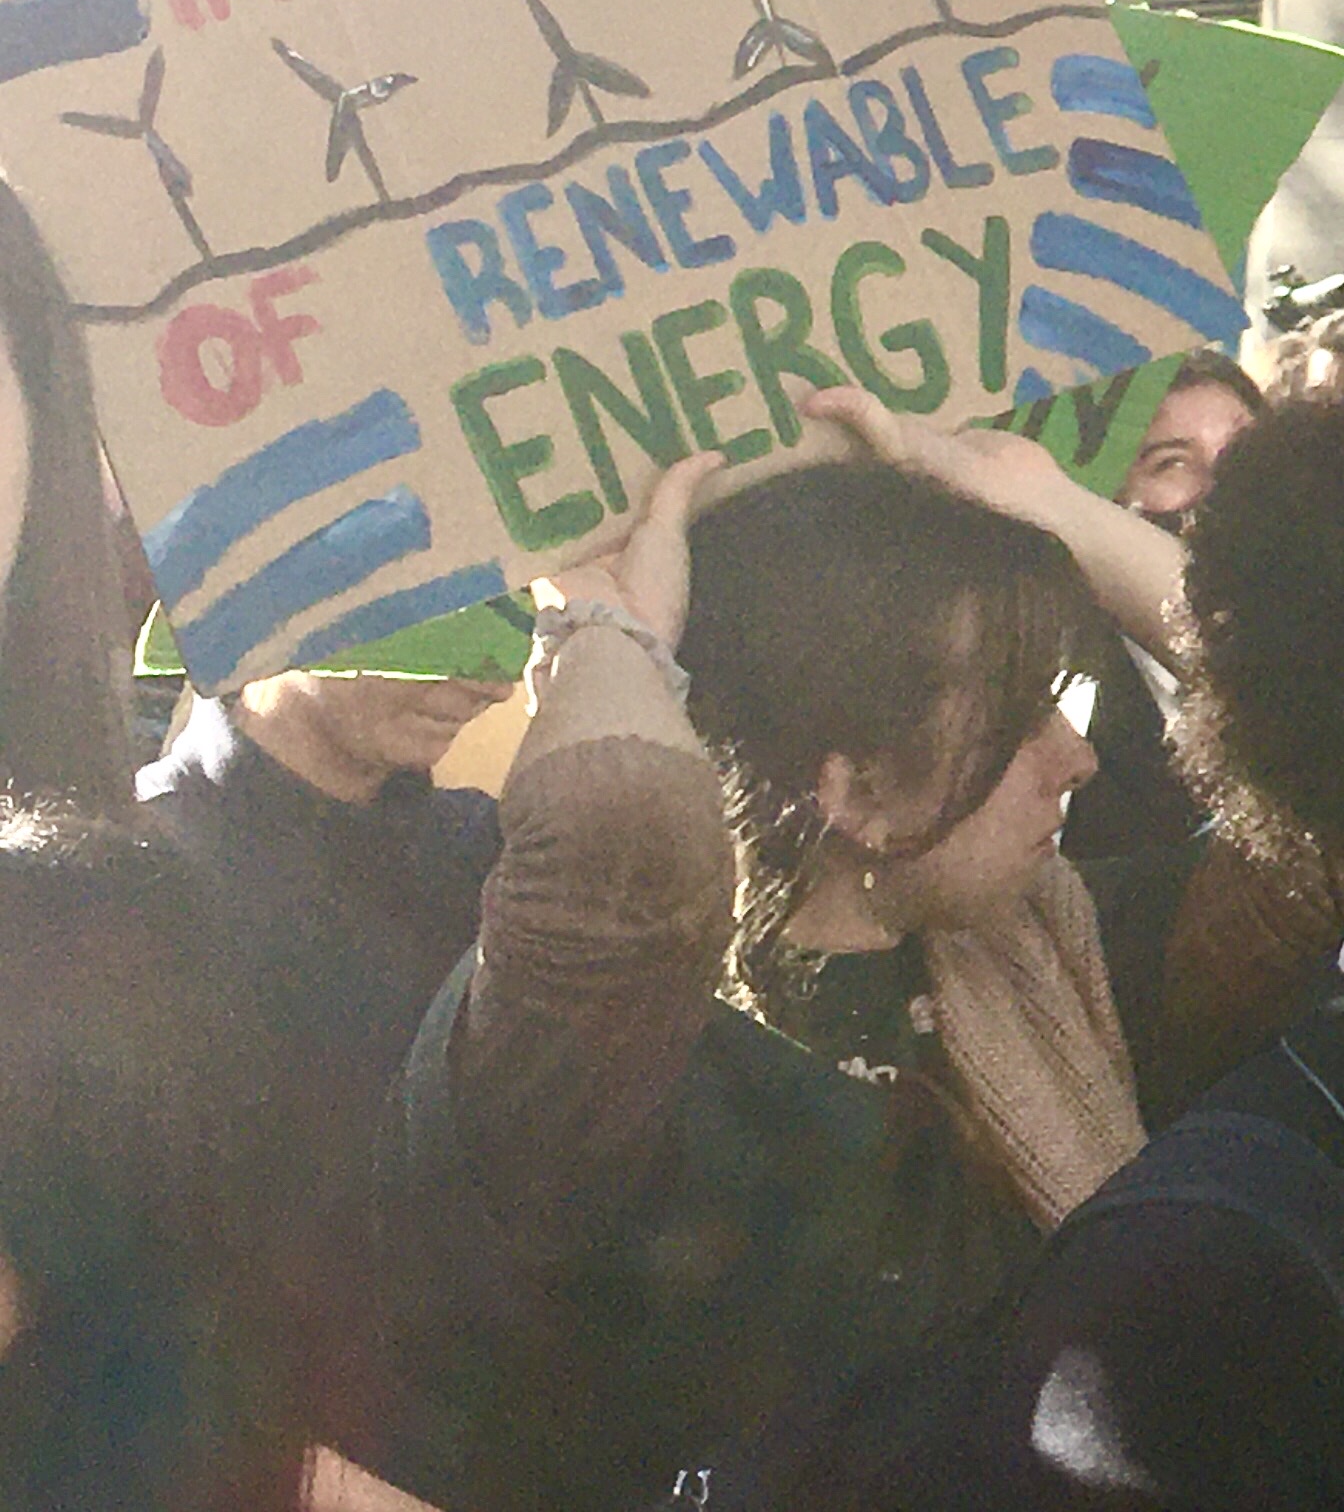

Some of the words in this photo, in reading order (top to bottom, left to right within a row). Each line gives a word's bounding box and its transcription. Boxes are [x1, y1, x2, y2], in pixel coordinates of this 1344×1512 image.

[155, 267, 323, 428] OF
[424, 46, 1063, 344] RENEWABLE
[448, 215, 1013, 553] ENERGY
